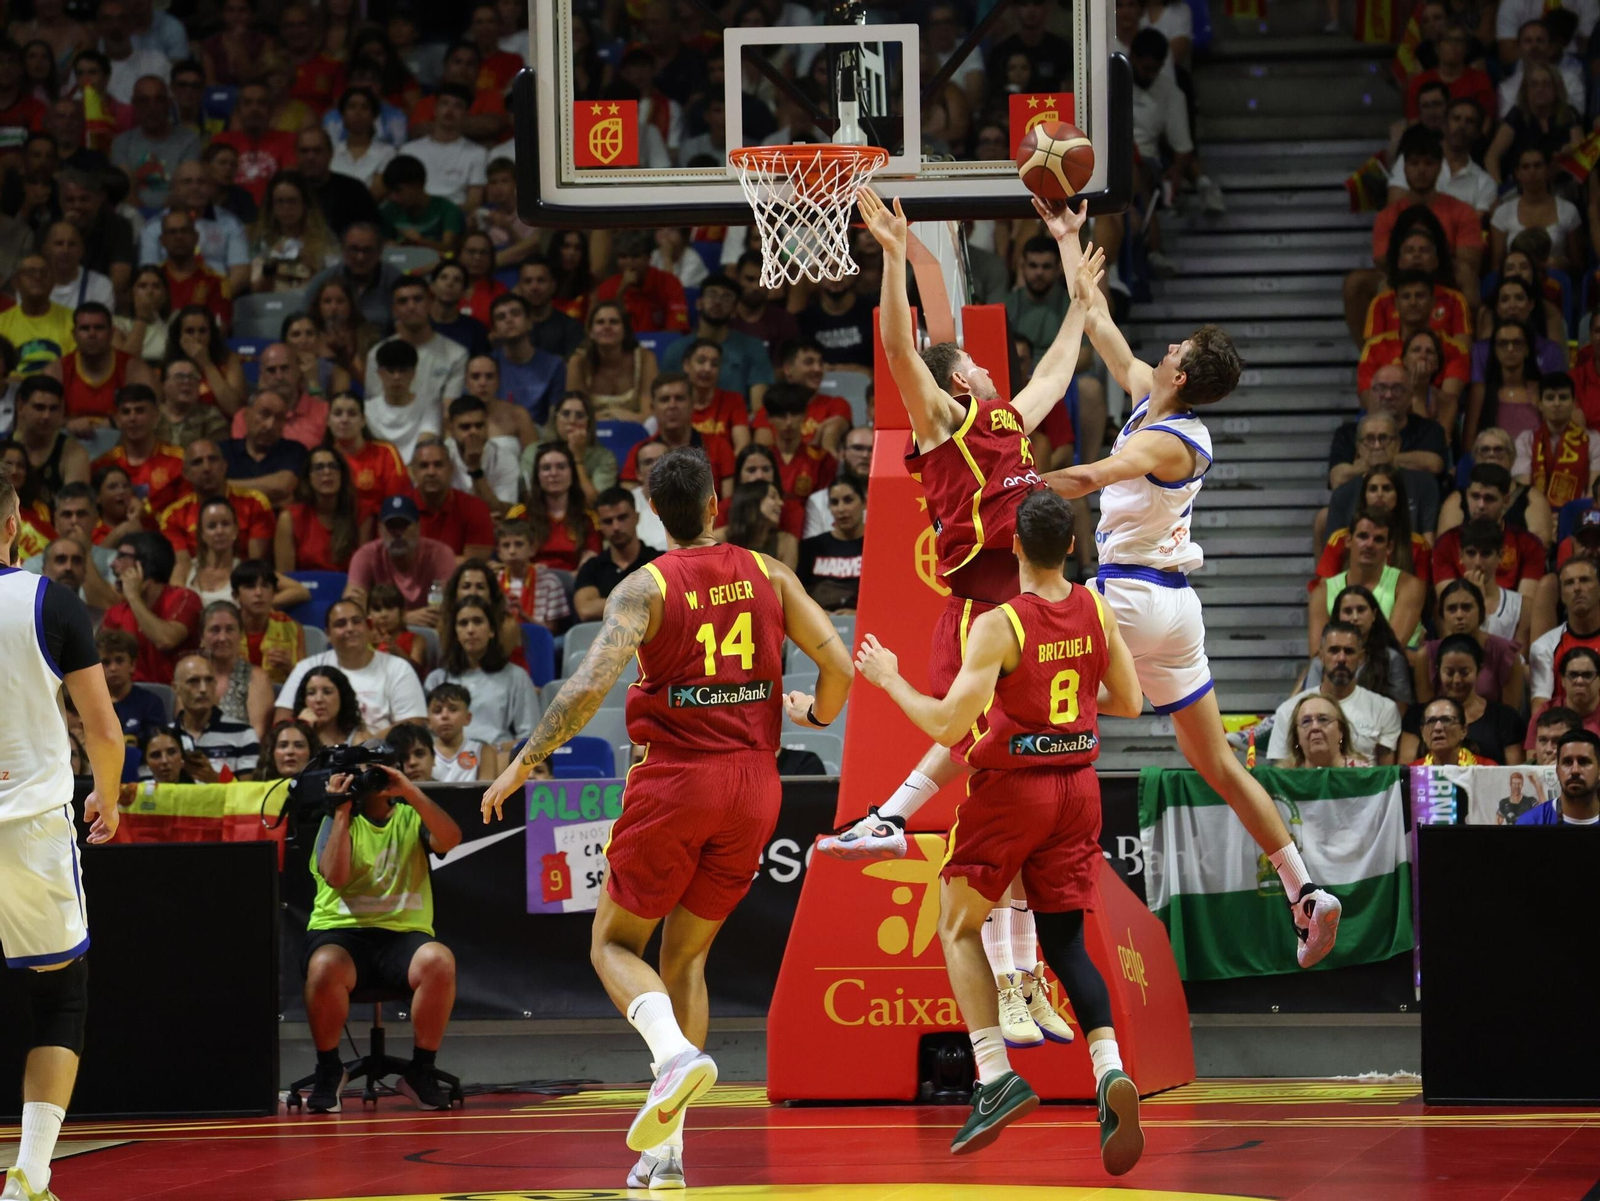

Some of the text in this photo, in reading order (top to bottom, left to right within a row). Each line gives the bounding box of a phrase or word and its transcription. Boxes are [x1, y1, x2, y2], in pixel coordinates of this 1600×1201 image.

[812, 555, 863, 578] MARVE
[684, 580, 755, 611] W. GEUER
[695, 611, 756, 677] 14
[1038, 635, 1093, 663] BRIZUELA
[695, 682, 767, 705] CaixaBank
[1048, 668, 1081, 725] 8
[1035, 734, 1095, 754] CaixaBa
[528, 783, 624, 821] ALBE
[549, 870, 563, 891] 9
